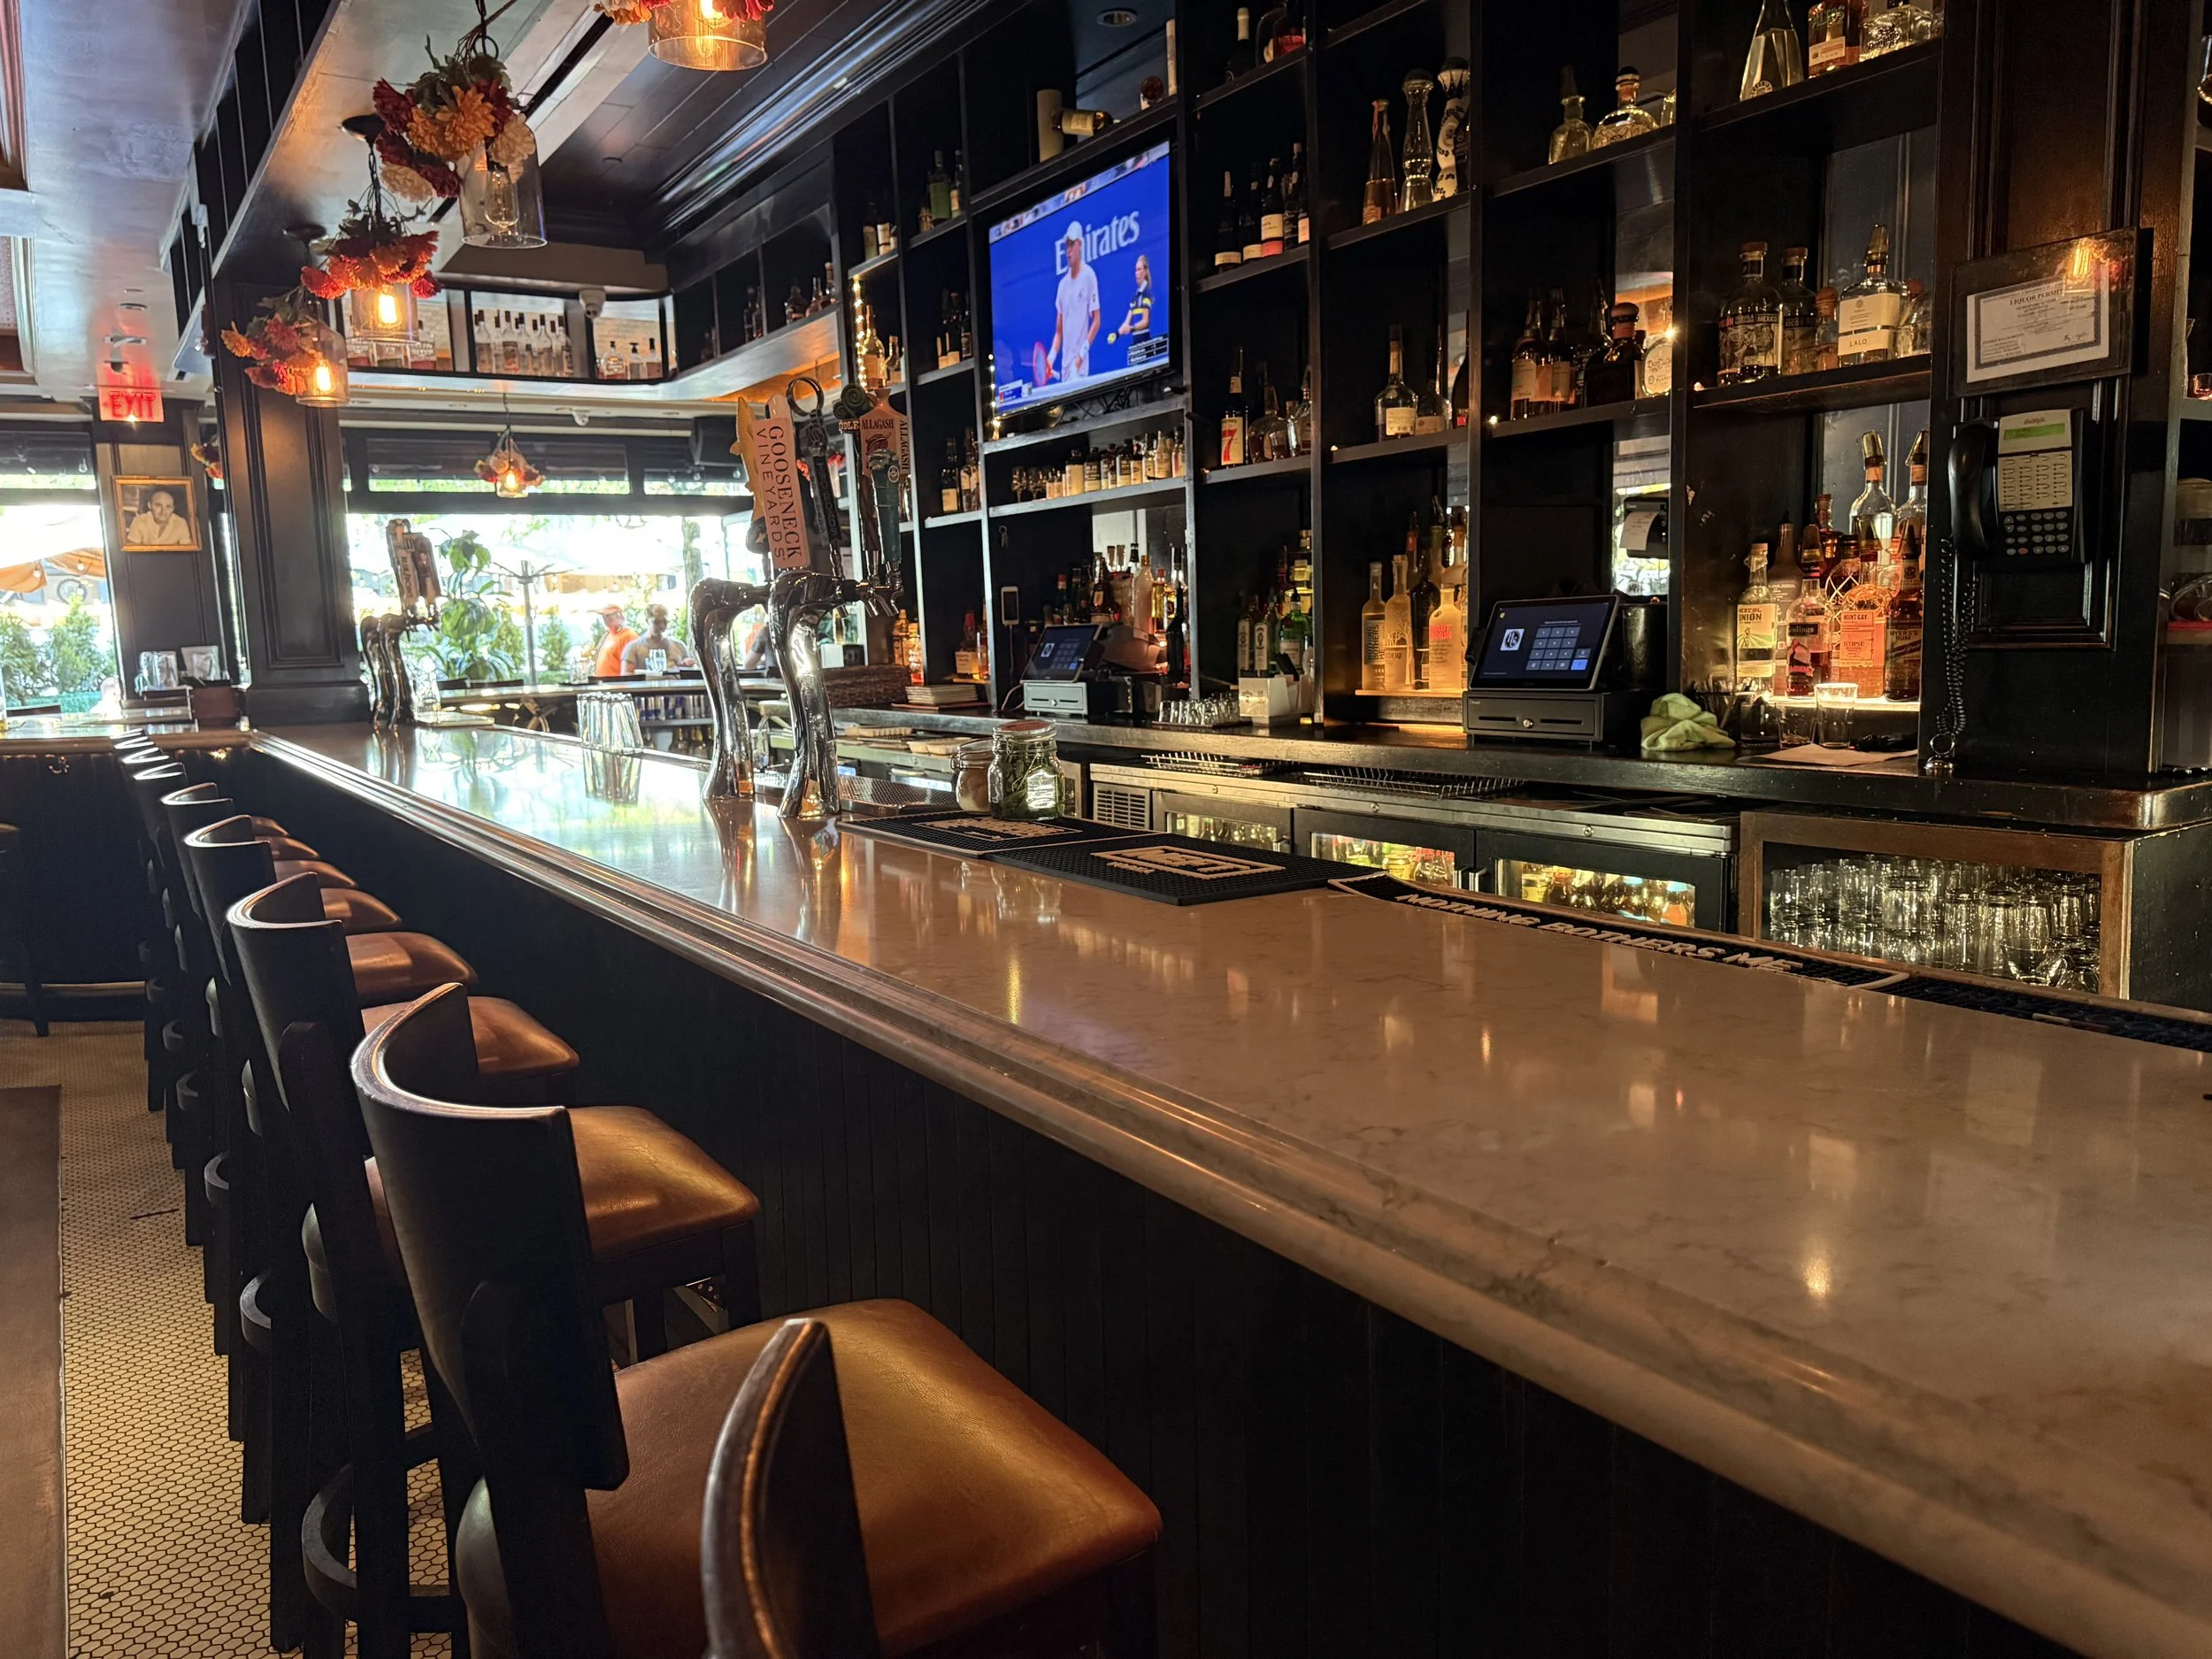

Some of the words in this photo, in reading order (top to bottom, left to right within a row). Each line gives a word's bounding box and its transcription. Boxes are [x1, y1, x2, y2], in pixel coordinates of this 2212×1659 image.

[2009, 295, 2036, 306] LIQUOR
[2037, 288, 2063, 300] PERMIT
[1849, 338, 1868, 348] LALO
[109, 391, 156, 419] EXIT
[861, 419, 895, 431] ALLAGASH
[899, 419, 910, 471] ALLAGASH
[1222, 428, 1239, 462] 7
[757, 428, 785, 559] VINEYARDS
[769, 426, 802, 559] GOOSENECK
[1792, 626, 1815, 635] slings
[1394, 894, 1541, 926] NOTHING
[1537, 921, 1726, 959] BOTHERS
[1723, 952, 1803, 973] ME
